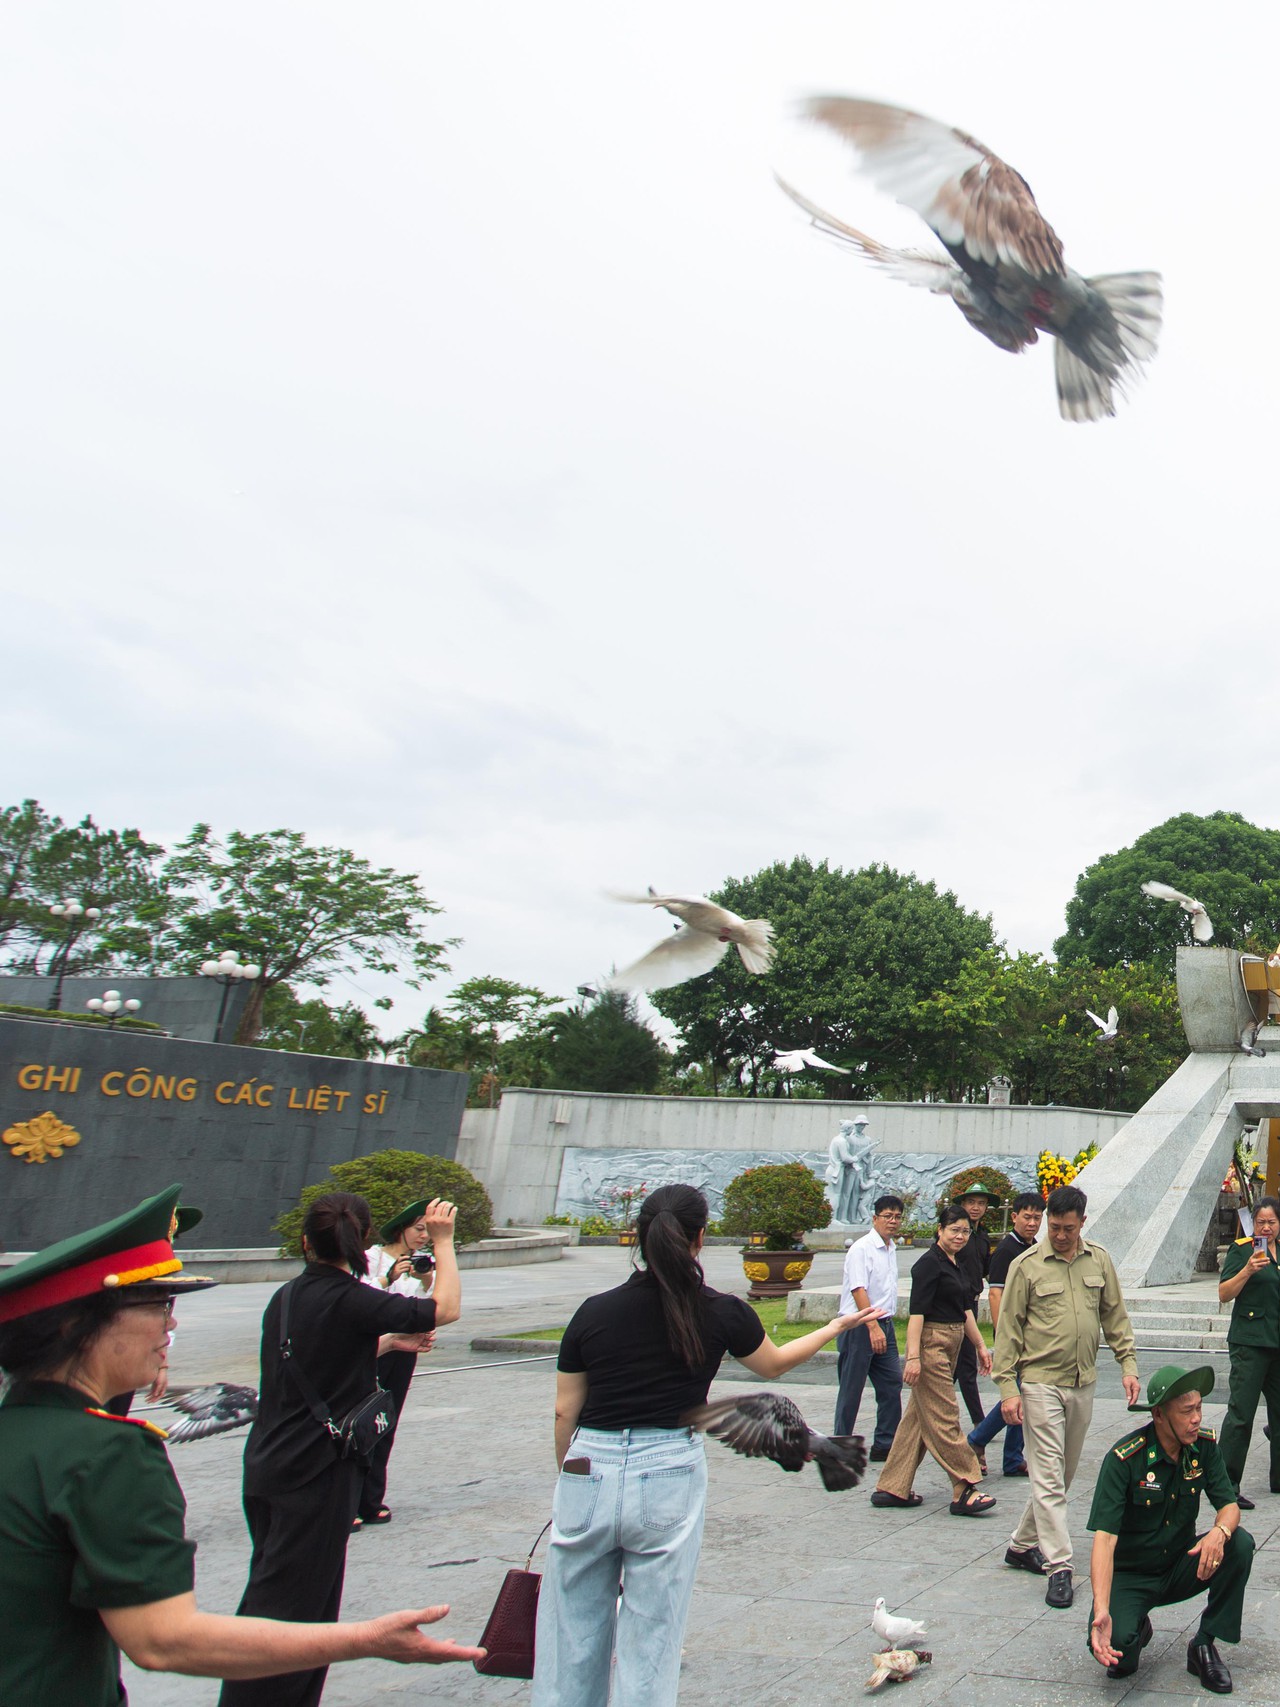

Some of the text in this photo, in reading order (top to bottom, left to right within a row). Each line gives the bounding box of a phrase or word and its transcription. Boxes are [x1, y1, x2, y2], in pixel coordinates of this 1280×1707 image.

[17, 1064, 388, 1115] GHI CÔNG CÁC LIỆT SĨ
